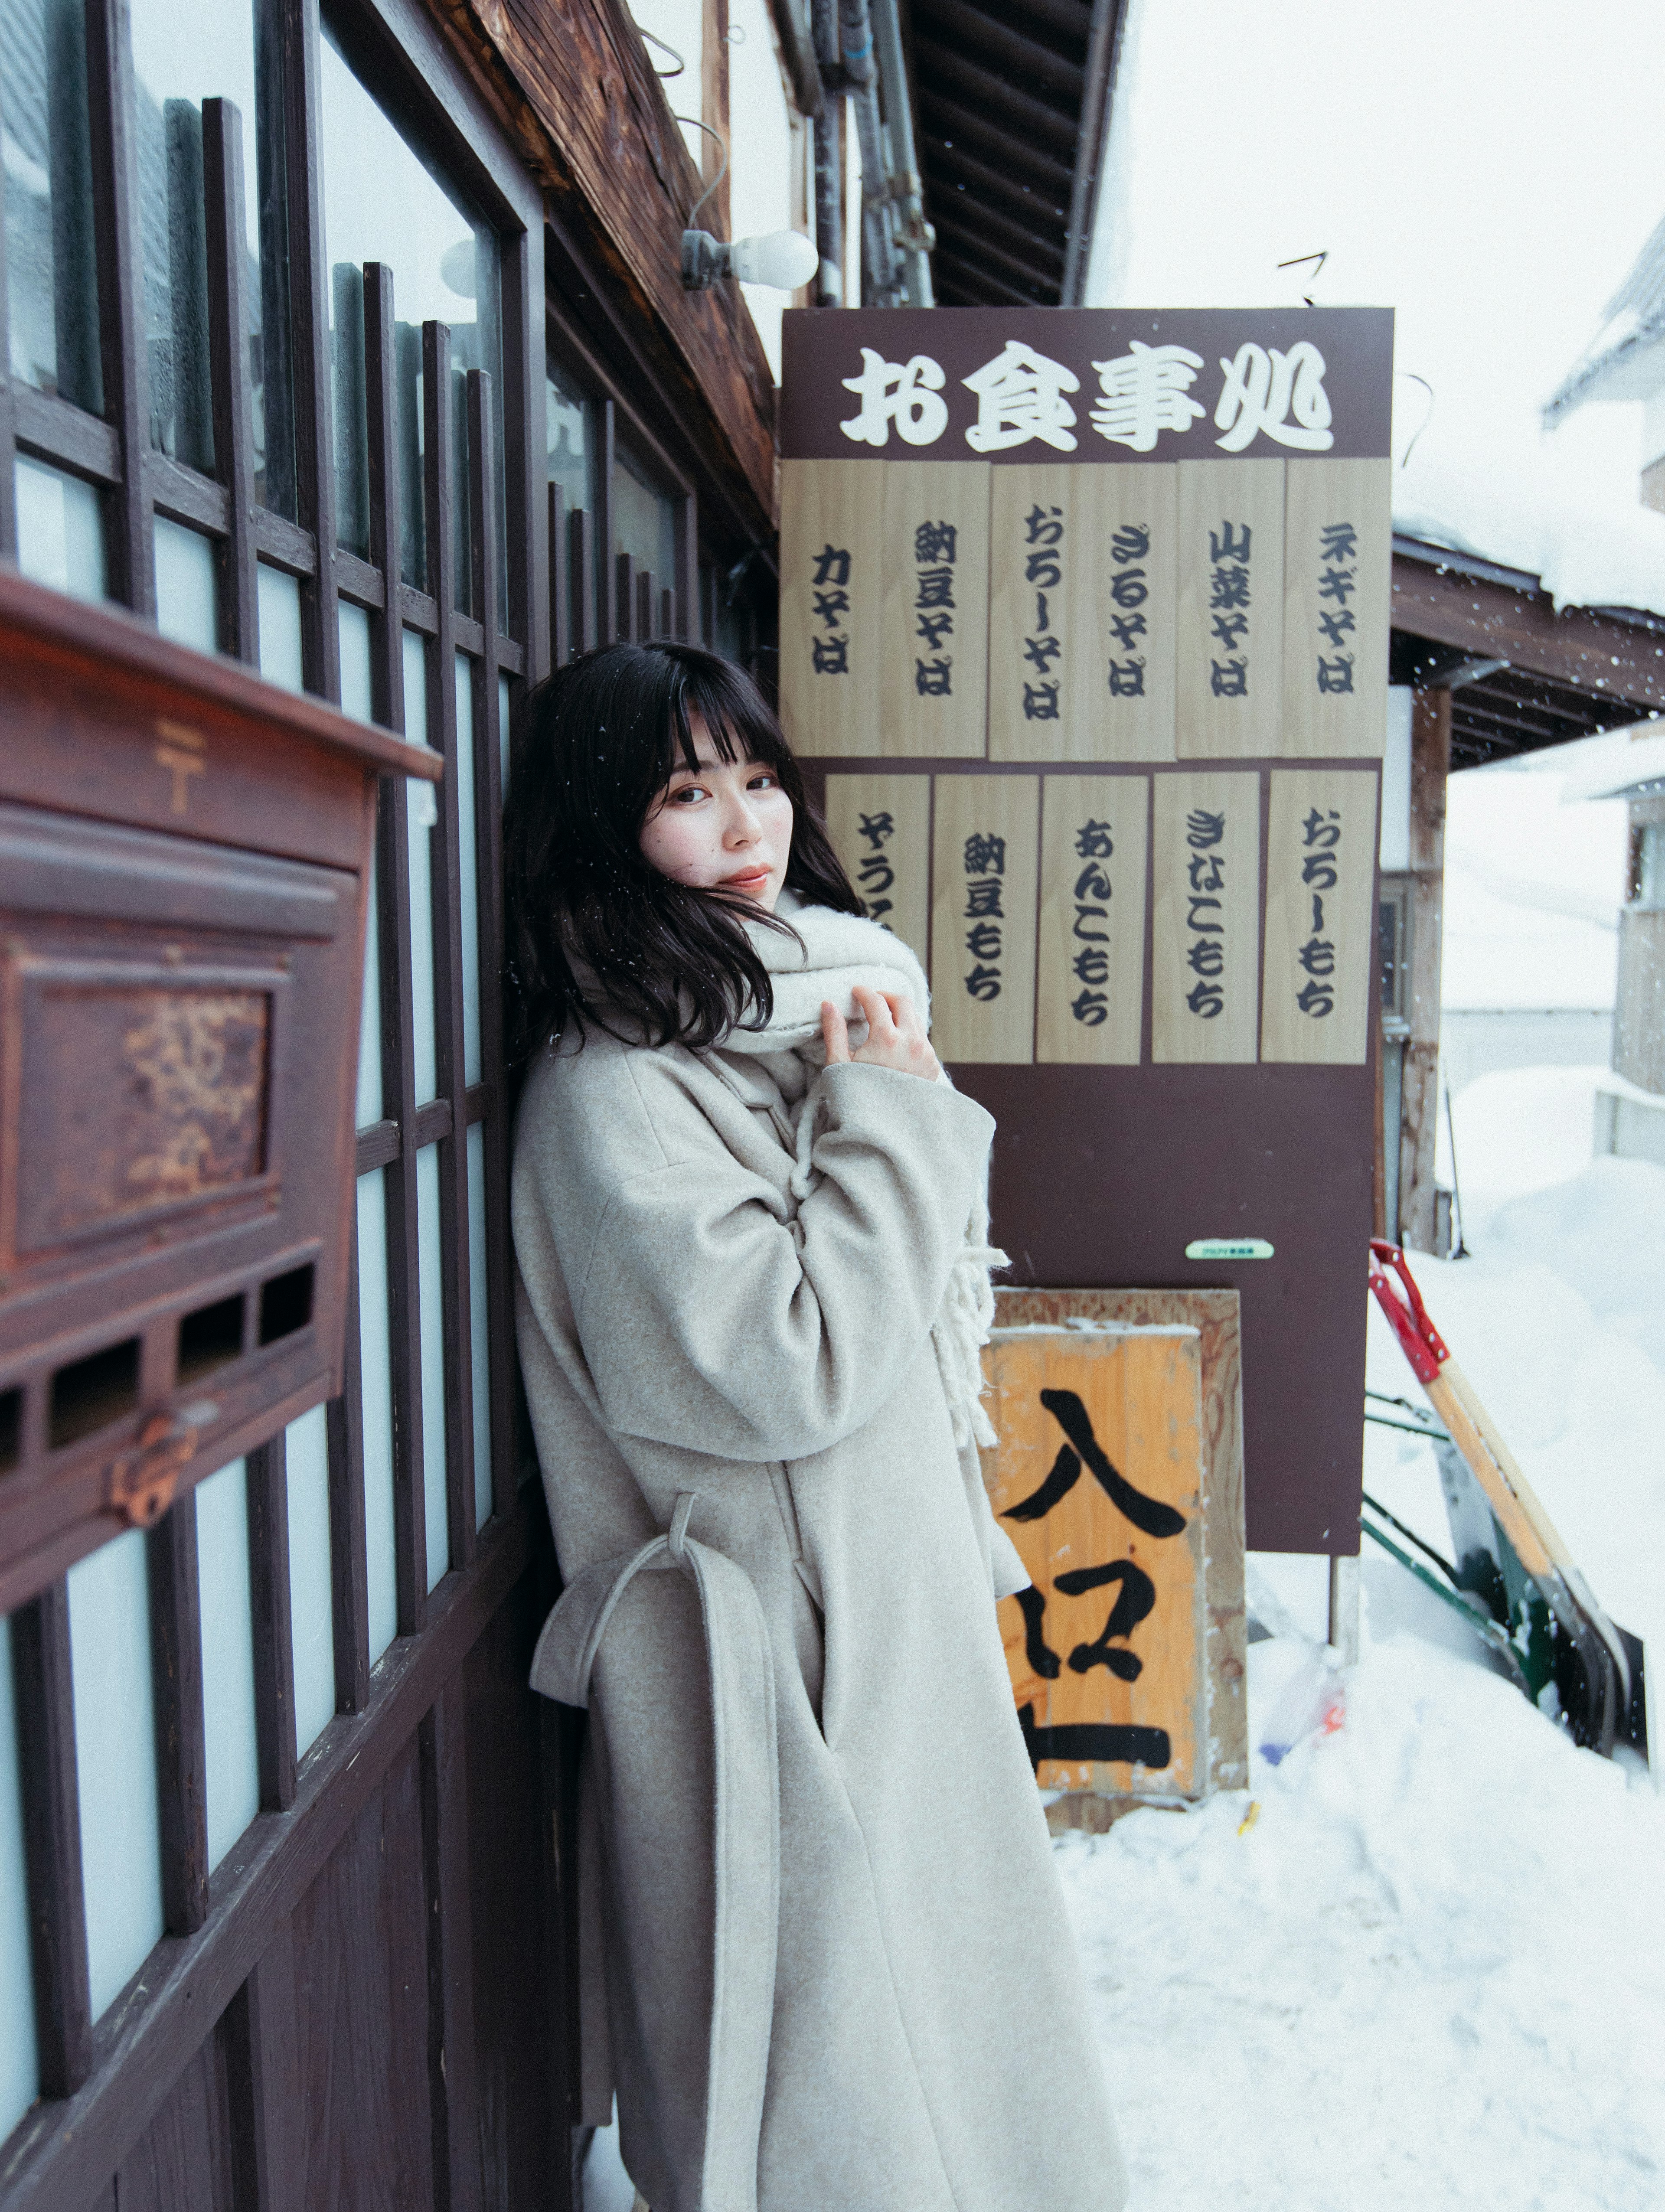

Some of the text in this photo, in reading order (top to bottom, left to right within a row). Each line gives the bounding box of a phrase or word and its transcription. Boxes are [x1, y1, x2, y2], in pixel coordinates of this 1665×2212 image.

[840, 340, 1334, 453] お食事処
[811, 543, 852, 675] 力そば
[914, 520, 958, 697] 納豆そば
[1107, 523, 1150, 698] ざるそば
[1208, 519, 1253, 698] 山菜そば
[1316, 522, 1358, 695] ネギそば
[963, 832, 1006, 1002] 納豆もち
[1070, 818, 1114, 1028] あんこもち
[1185, 809, 1226, 1020] きなこもち
[1000, 1389, 1187, 1682] 入口
